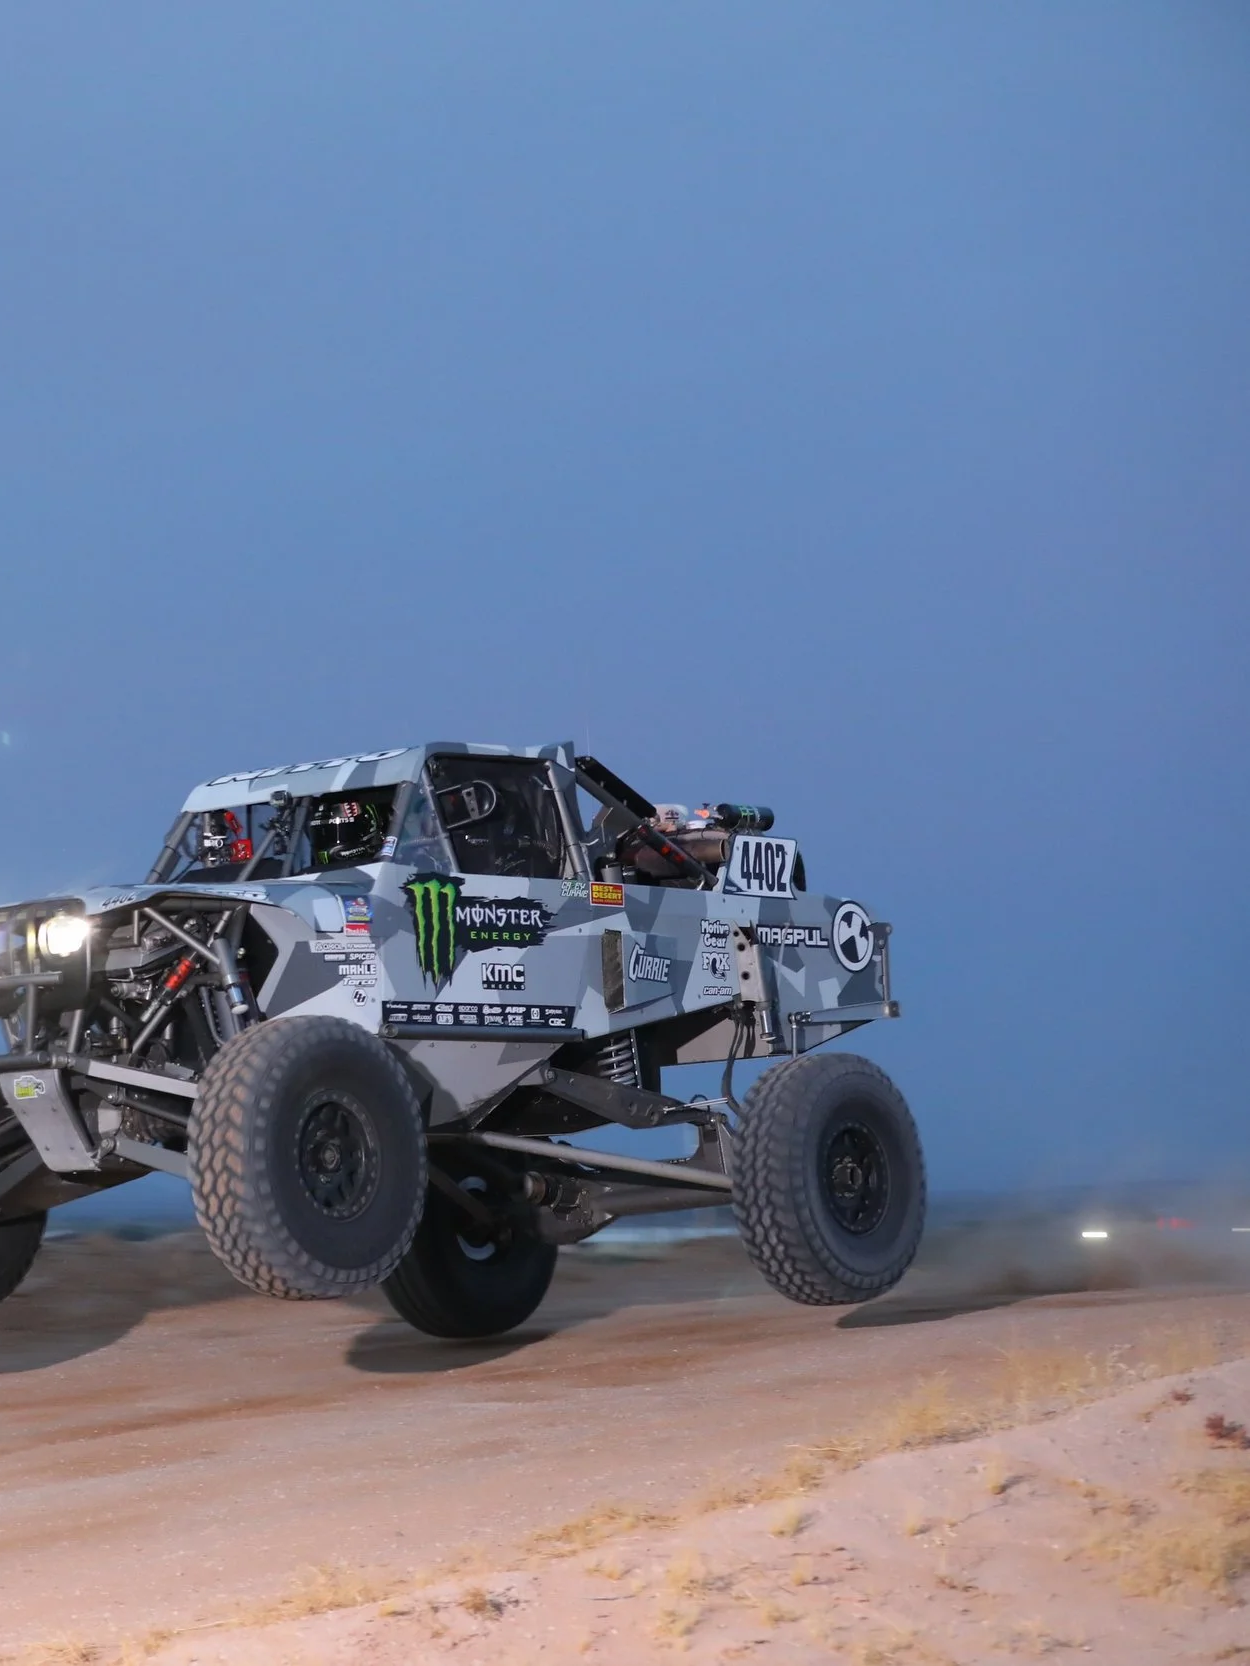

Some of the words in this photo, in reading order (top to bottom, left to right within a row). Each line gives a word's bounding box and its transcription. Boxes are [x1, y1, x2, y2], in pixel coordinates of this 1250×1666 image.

[741, 840, 787, 892] 4402
[561, 881, 586, 890] CAEY
[592, 884, 614, 893] BEST
[561, 888, 589, 898] CURRIE
[592, 891, 622, 900] DESERT
[455, 903, 543, 928] MONSTER
[701, 920, 730, 935] Motive
[470, 931, 531, 941] ENERGY
[703, 934, 727, 948] Gear
[758, 926, 829, 946] MAGPUL
[349, 952, 376, 961] SPICER
[338, 963, 377, 976] MAHLE
[629, 945, 671, 983] CURRIE
[702, 952, 730, 977] FOX
[481, 963, 525, 983] KMC
[703, 986, 732, 996] can-am
[504, 1006, 527, 1014] ARP
